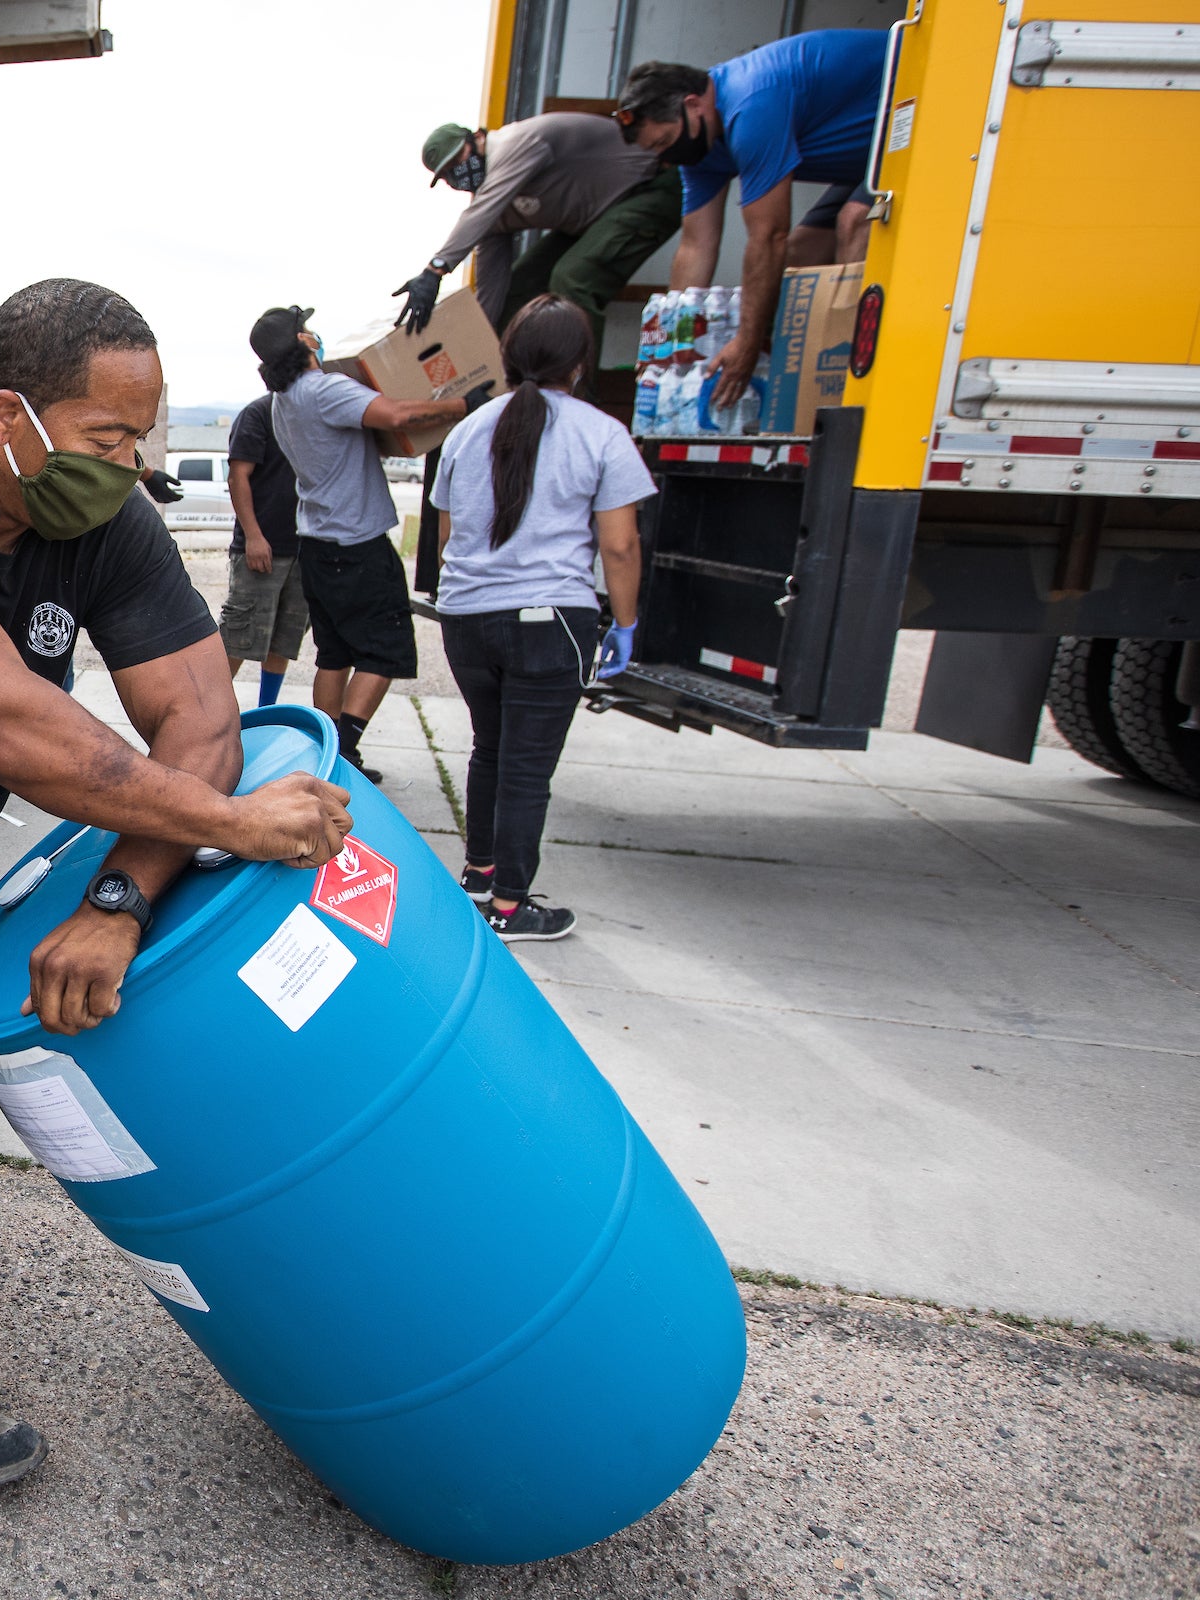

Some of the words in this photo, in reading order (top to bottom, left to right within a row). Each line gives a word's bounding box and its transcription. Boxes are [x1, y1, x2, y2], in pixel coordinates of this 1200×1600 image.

[785, 277, 816, 374] MEDIUM
[176, 514, 199, 522] GAME
[209, 514, 230, 522] FISH
[327, 881, 373, 907] FLAMMABLE
[370, 873, 393, 891] LIQUID
[374, 922, 385, 935] 3
[279, 979, 289, 989] NOT
[287, 971, 296, 981] FOR
[294, 944, 320, 973] CONSUMPTION
